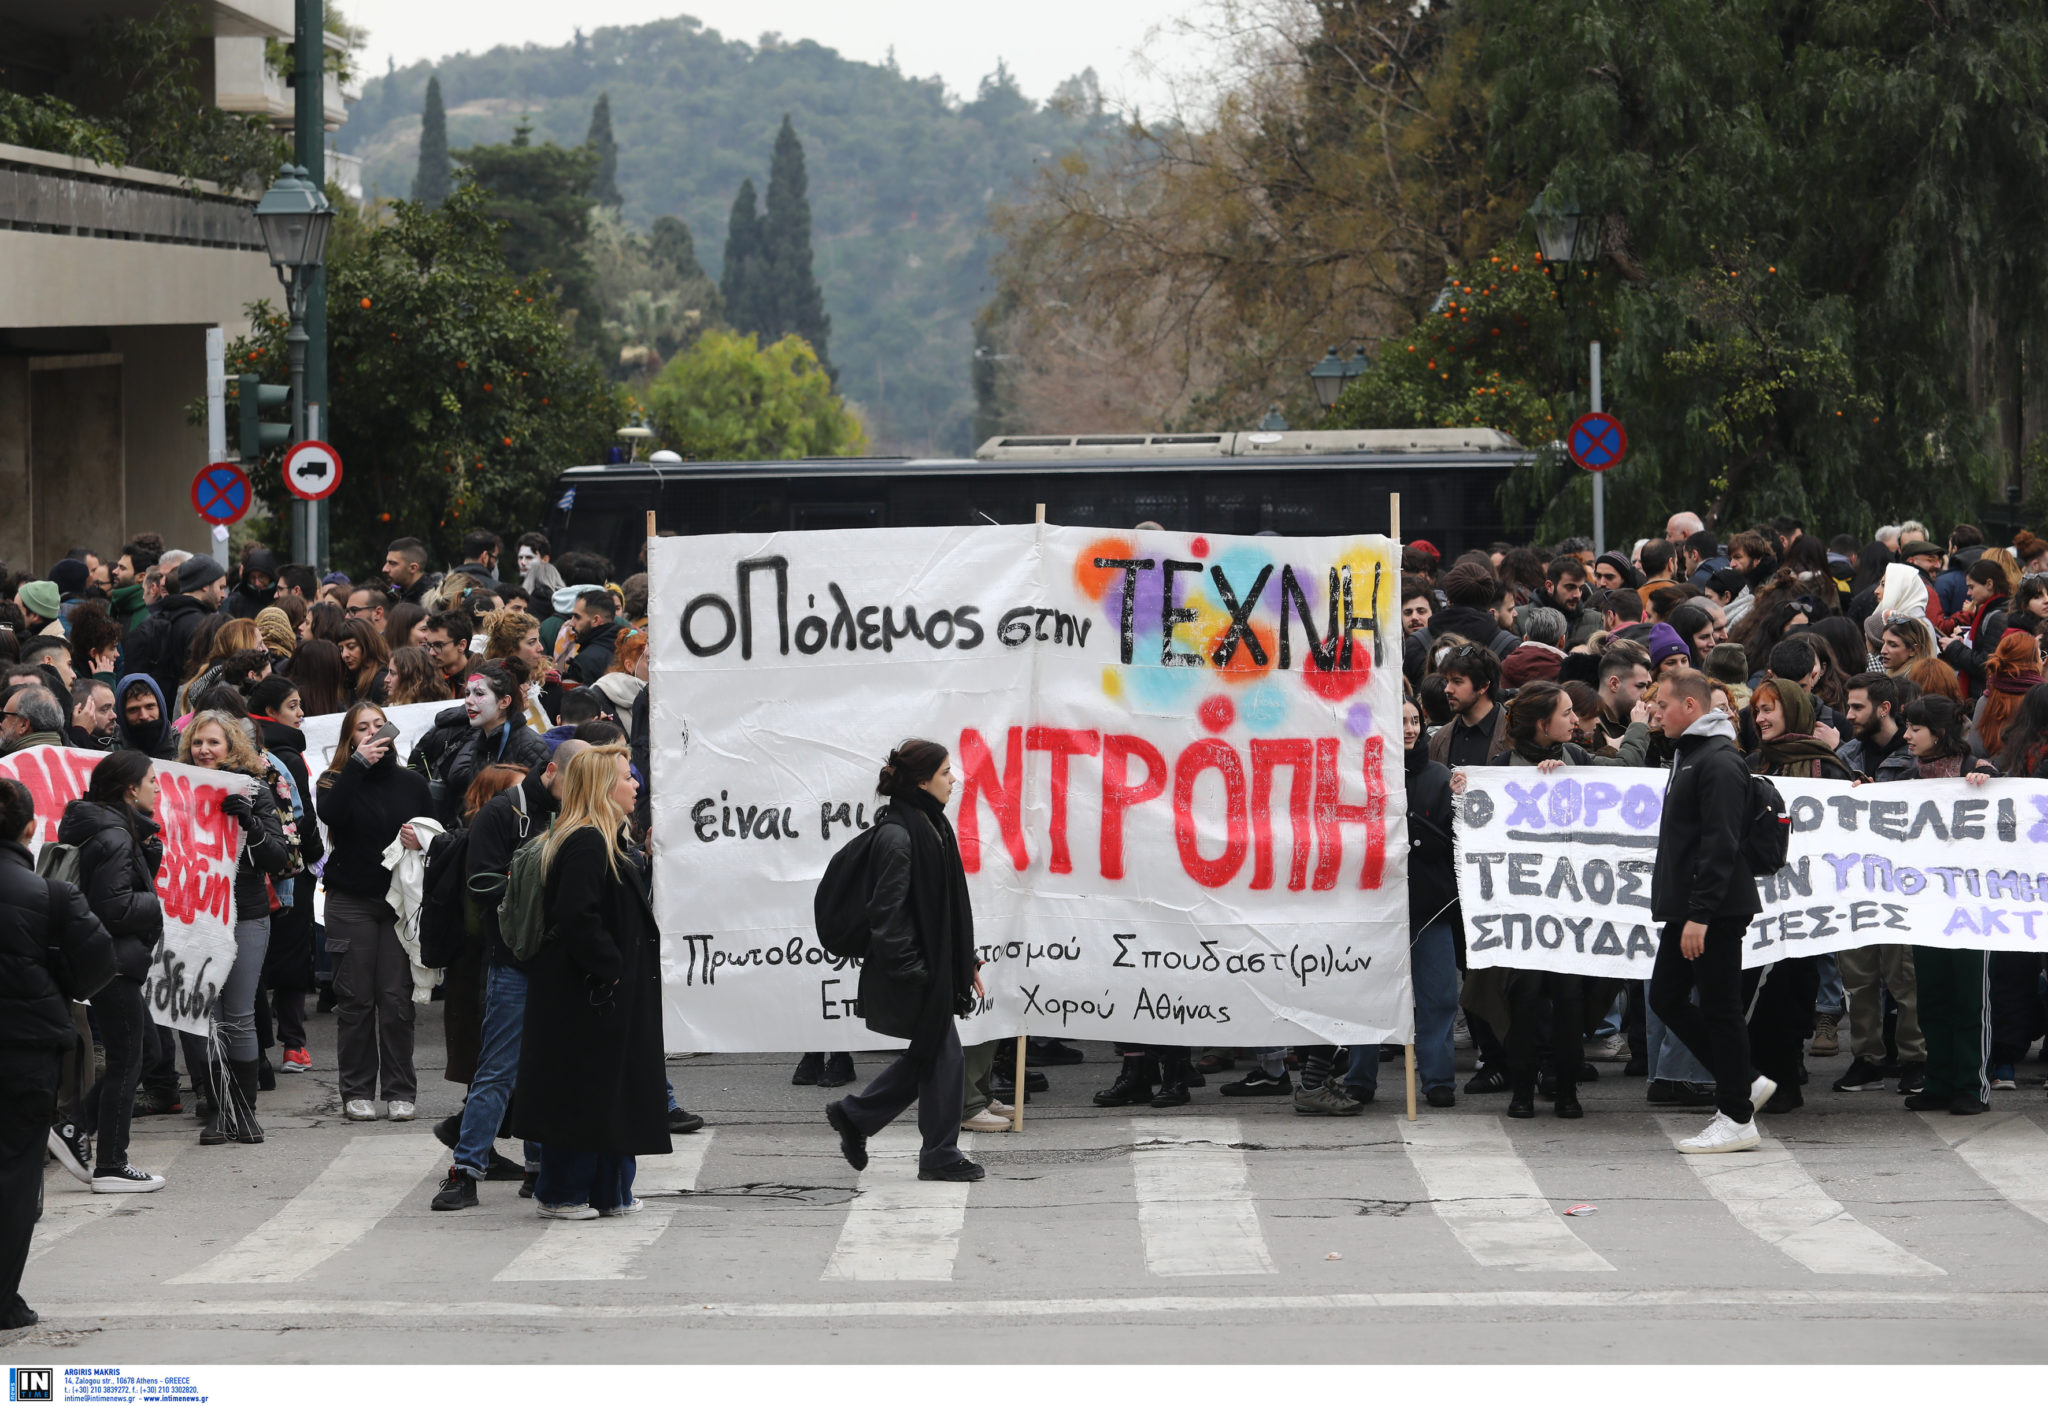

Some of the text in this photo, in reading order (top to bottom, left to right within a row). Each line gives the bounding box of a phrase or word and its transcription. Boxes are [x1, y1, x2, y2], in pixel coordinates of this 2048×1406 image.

[997, 606, 1092, 648] στην
[1094, 557, 1383, 671] ΤΕΧΝΗ
[691, 789, 799, 843] είναι
[957, 724, 1387, 892] ΝΤΡΟΠΗ
[1463, 788, 1495, 829] Ο
[1504, 777, 1667, 830] ΧΟΡΟ
[1789, 795, 2017, 843] ΟΤΕΛΕΙ
[1465, 851, 1655, 910] ΤΕΛΟΣ
[1019, 983, 1115, 1028] Χορού
[1133, 986, 1231, 1025] Αθήνας
